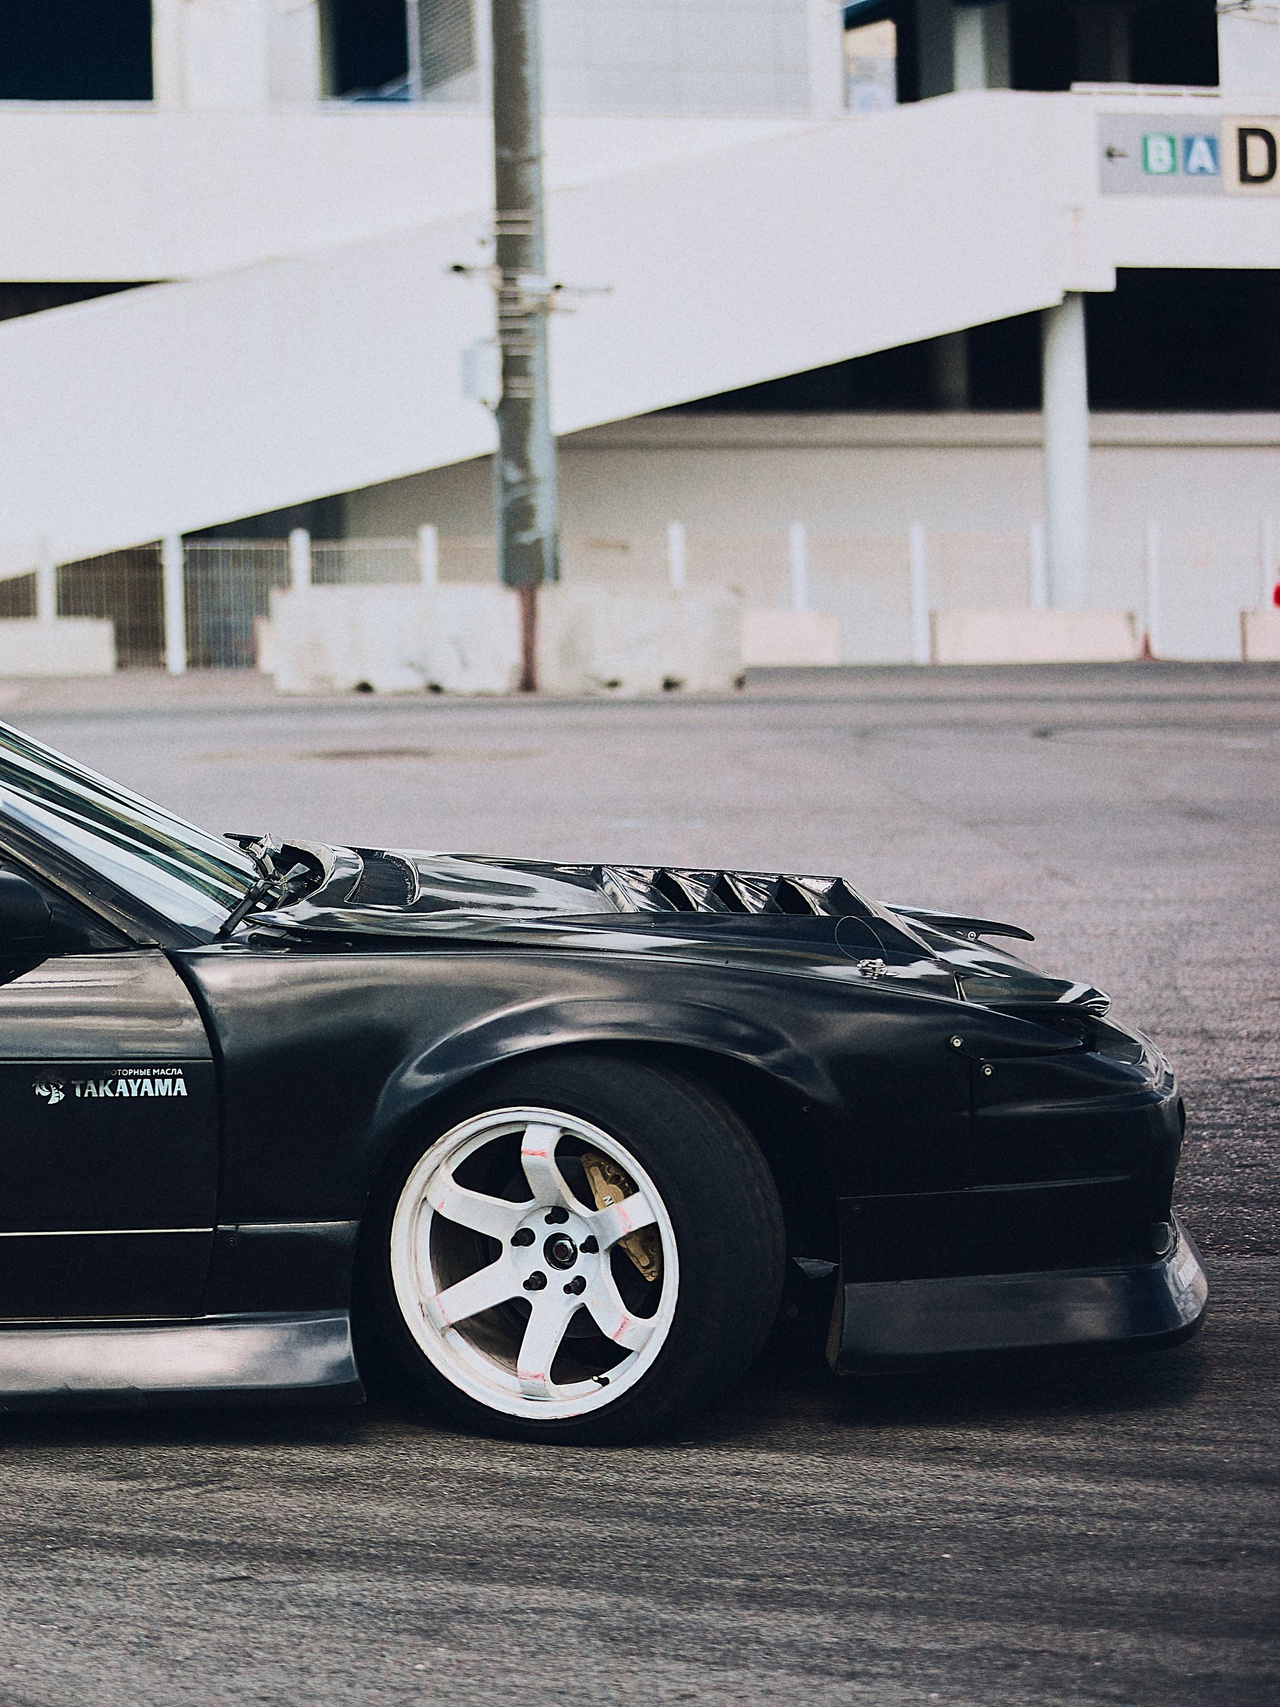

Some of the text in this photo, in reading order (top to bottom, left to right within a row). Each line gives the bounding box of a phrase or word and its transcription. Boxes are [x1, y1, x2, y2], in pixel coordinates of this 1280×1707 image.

[1238, 127, 1277, 184] D
[104, 1068, 183, 1076] ОТОРНЫЕ МАСЛА
[71, 1078, 188, 1098] TAKAYAMA
